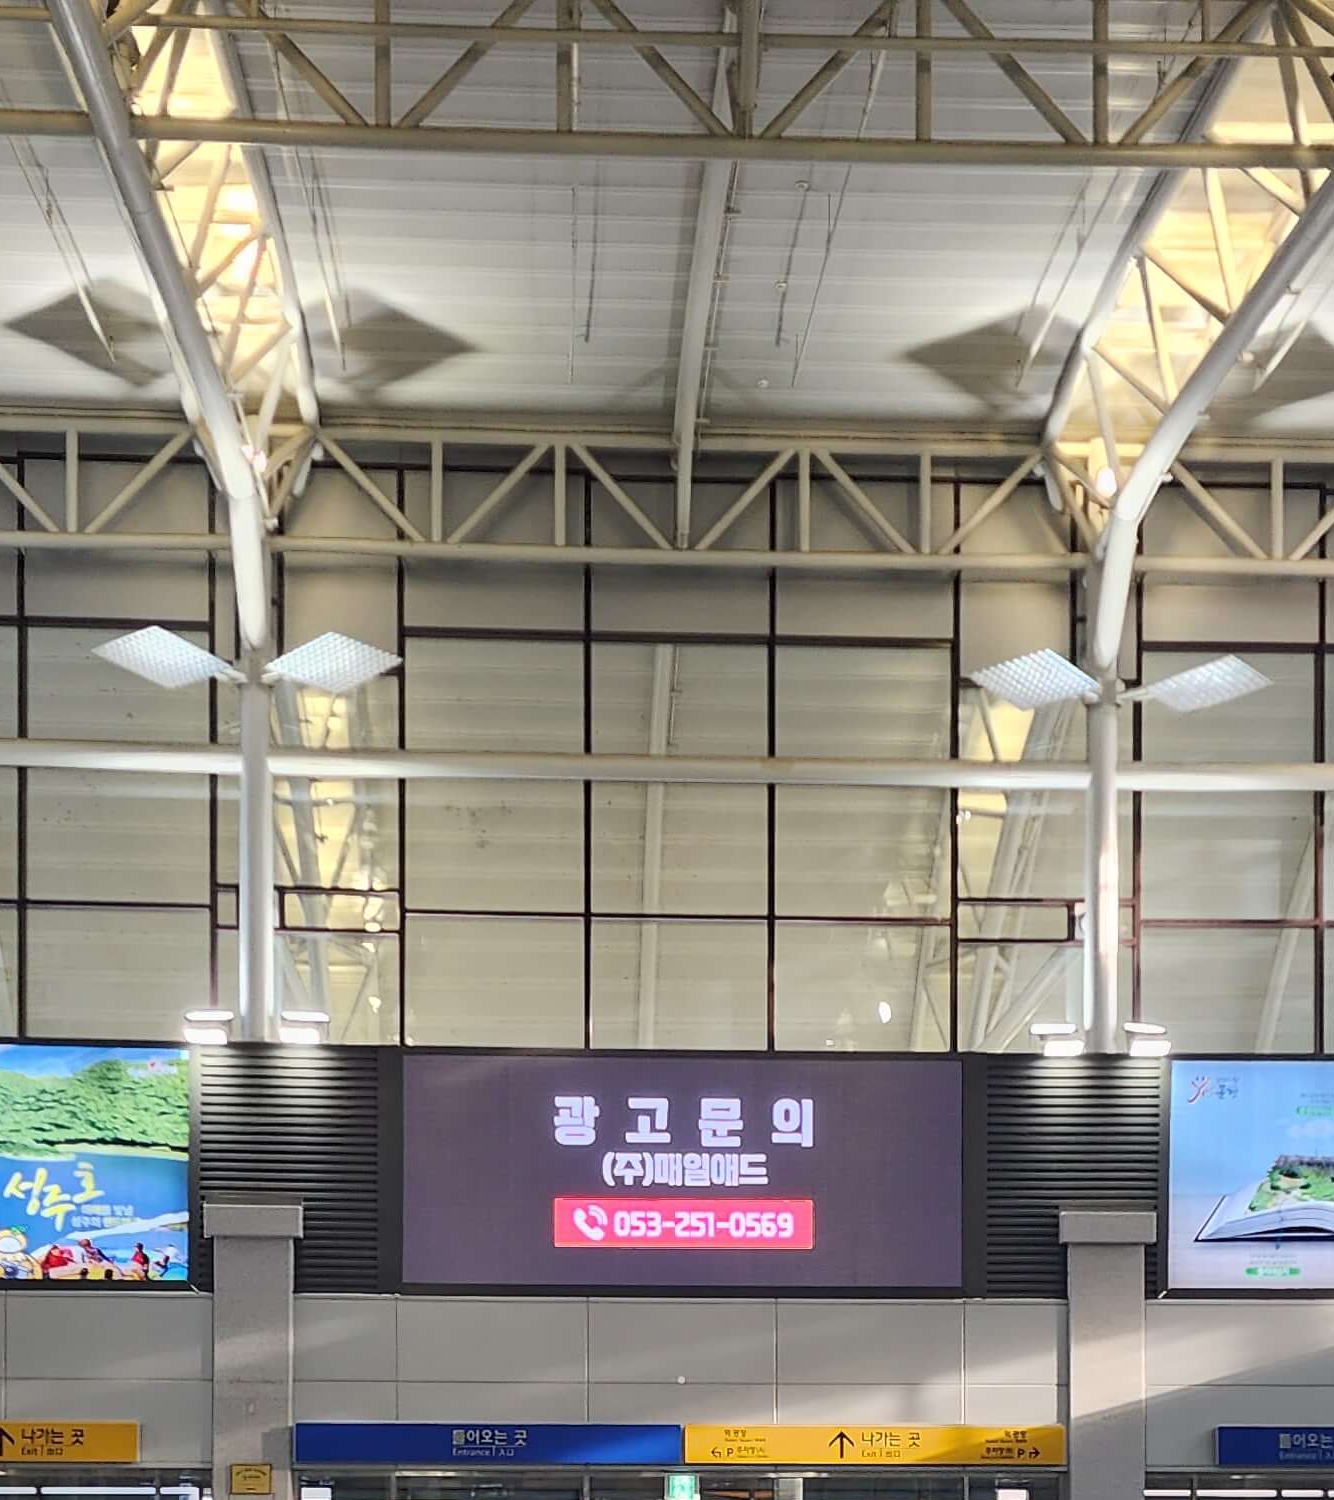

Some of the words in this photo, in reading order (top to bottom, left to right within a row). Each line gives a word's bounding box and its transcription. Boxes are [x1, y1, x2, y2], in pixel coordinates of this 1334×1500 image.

[601, 1151, 770, 1187] (주)매일애드
[613, 1210, 795, 1238] 053-251-0569
[21, 1427, 64, 1444] 나가는
[71, 1428, 84, 1445] 곳
[452, 1429, 507, 1445] 들어오는
[514, 1429, 527, 1446] 곳
[861, 1431, 901, 1448] 나가는
[908, 1432, 921, 1448] 곳
[1279, 1433, 1333, 1449] 들어오는
[452, 1447, 490, 1456] Entrance
[498, 1448, 515, 1456] 入口
